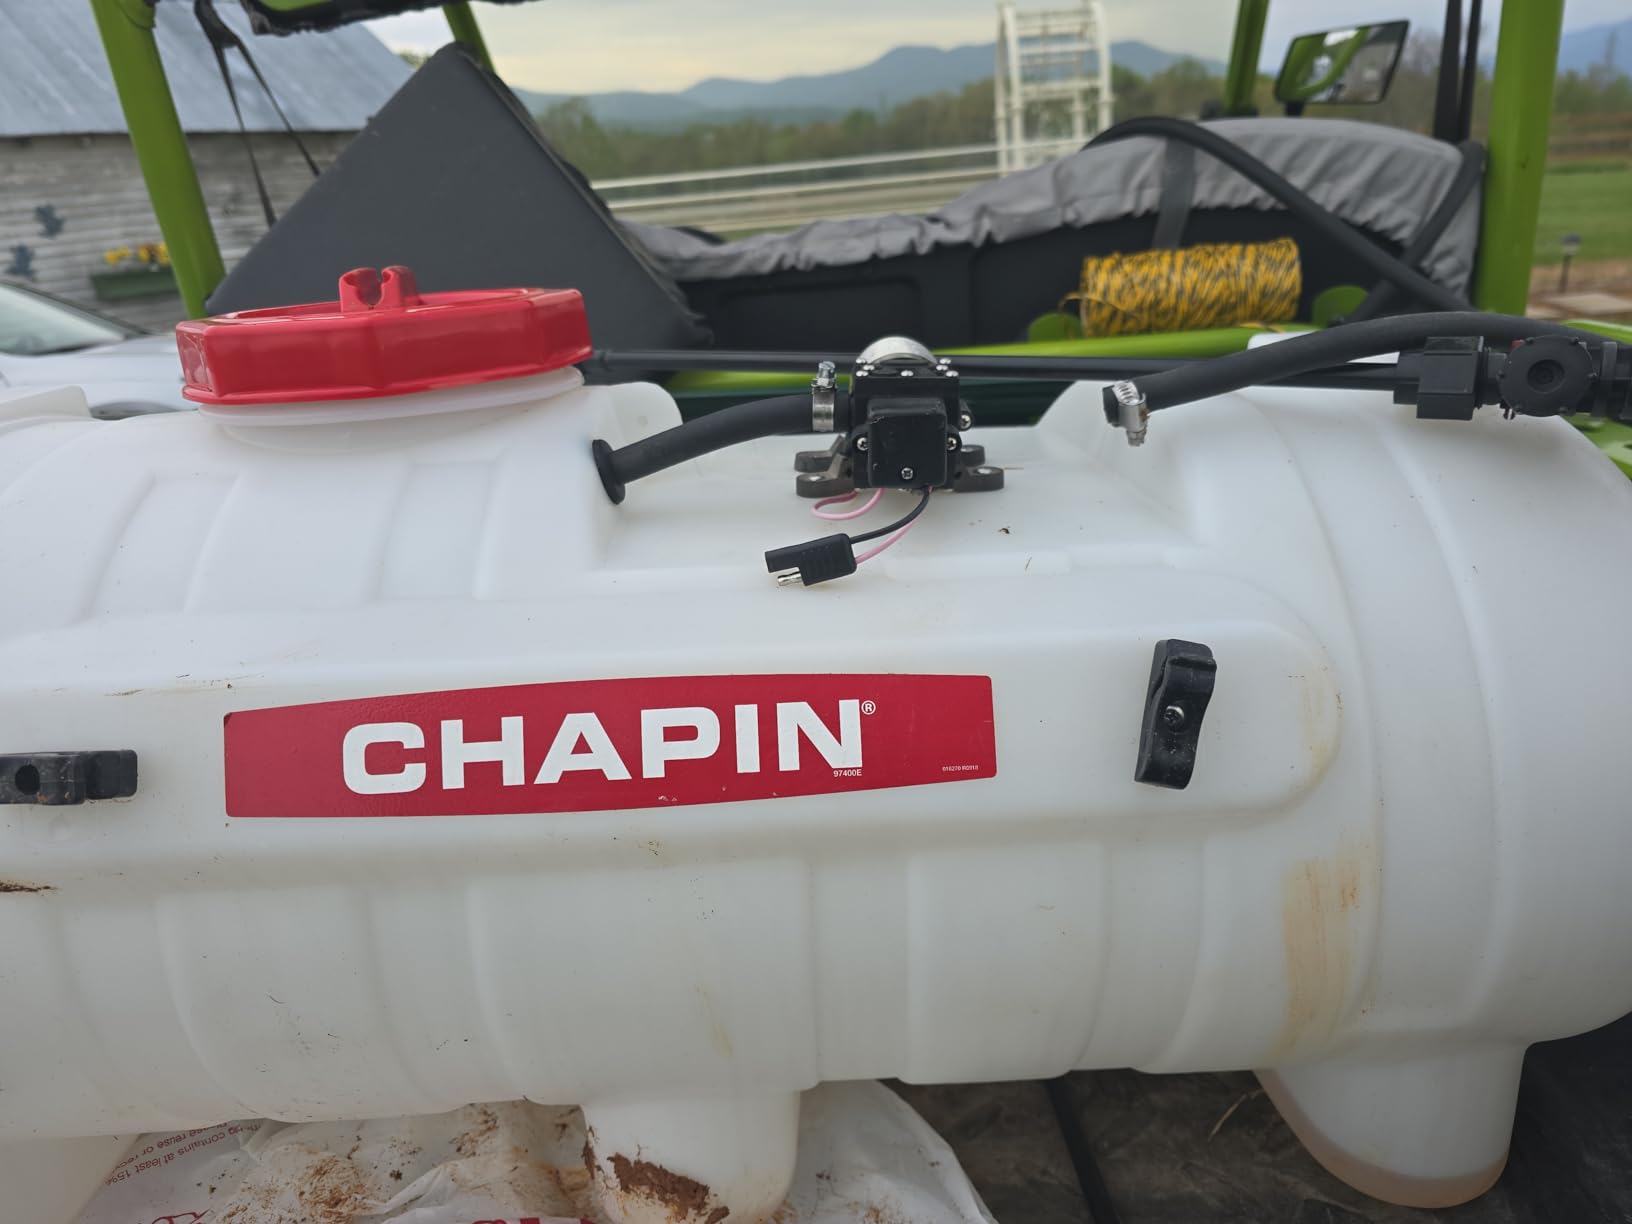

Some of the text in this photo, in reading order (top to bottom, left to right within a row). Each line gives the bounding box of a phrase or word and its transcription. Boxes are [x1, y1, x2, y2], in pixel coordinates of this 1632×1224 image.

[833, 768, 863, 778] 97400E
[157, 1134, 187, 1149] reuse
[177, 1131, 226, 1156] contains
[142, 1145, 154, 1156] or
[163, 1153, 175, 1164] at
[135, 1157, 162, 1174] least
